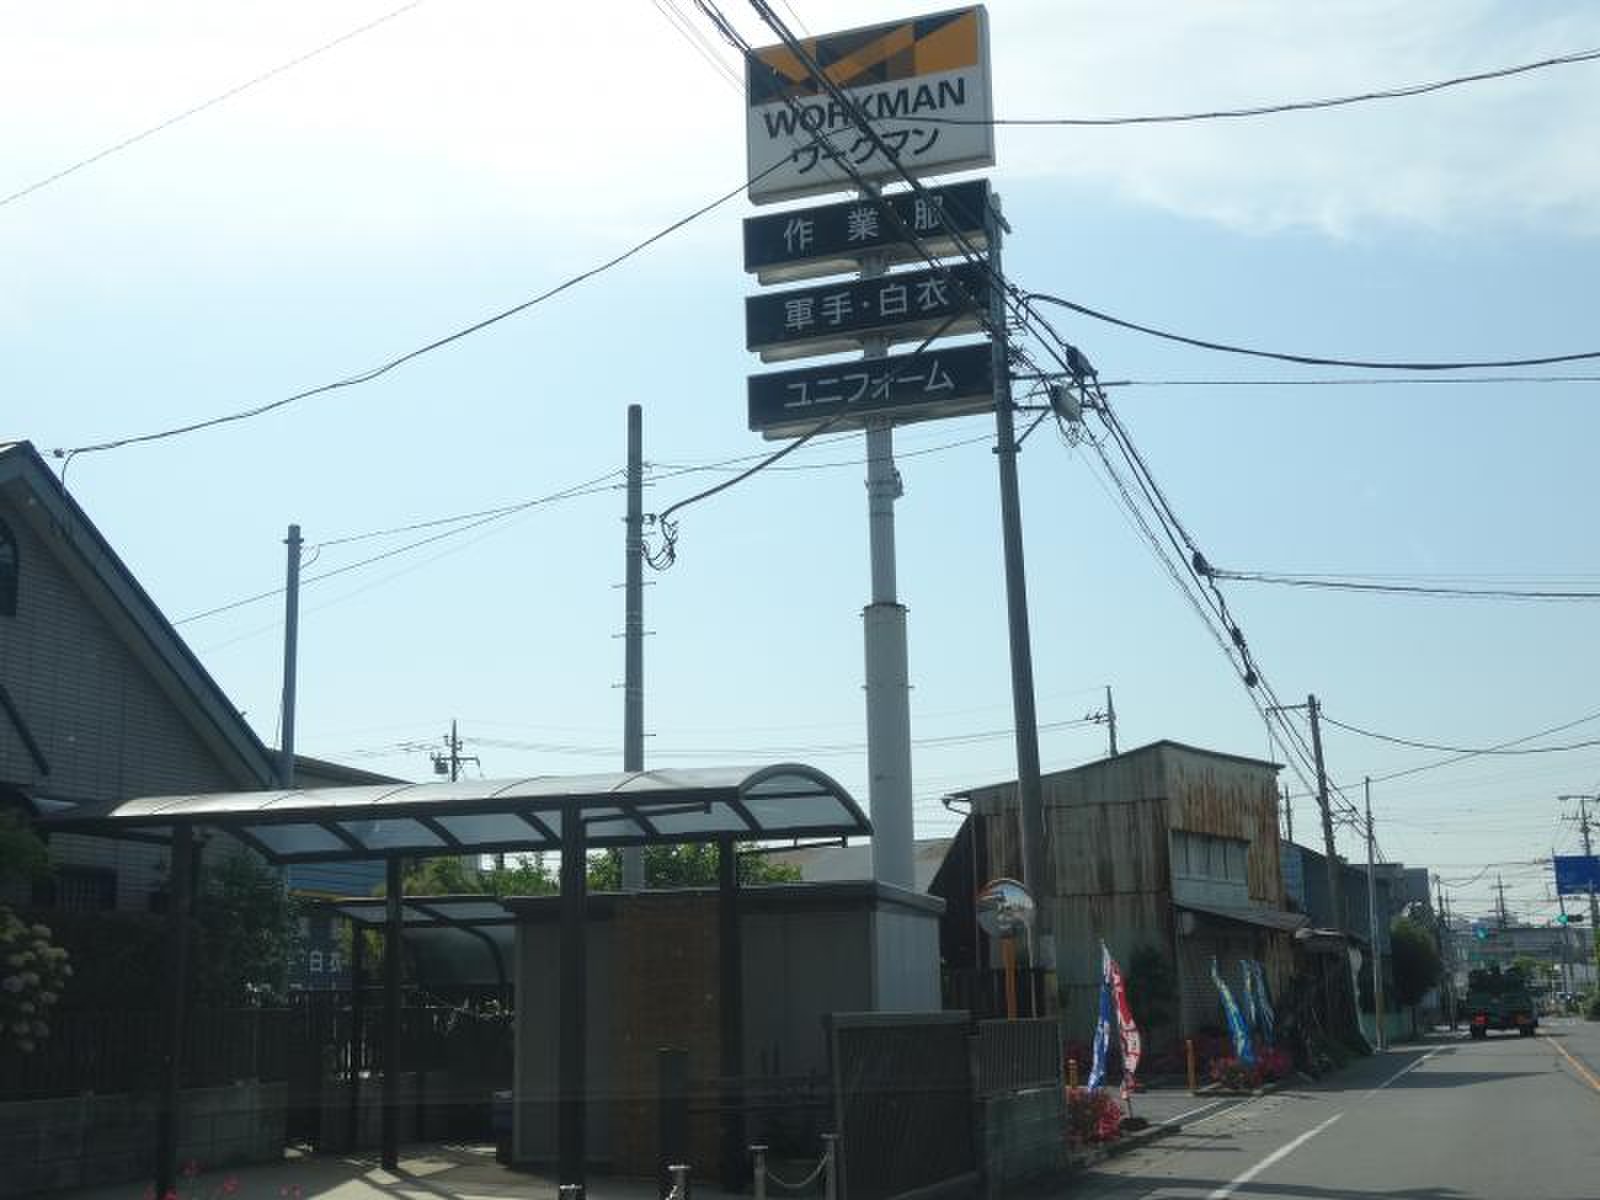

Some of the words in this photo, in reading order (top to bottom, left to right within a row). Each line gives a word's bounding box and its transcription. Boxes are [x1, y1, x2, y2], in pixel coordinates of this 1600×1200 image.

[764, 78, 966, 139] WORKMAN
[792, 128, 939, 175] ワークマン
[784, 360, 955, 408] ユニフォーム
